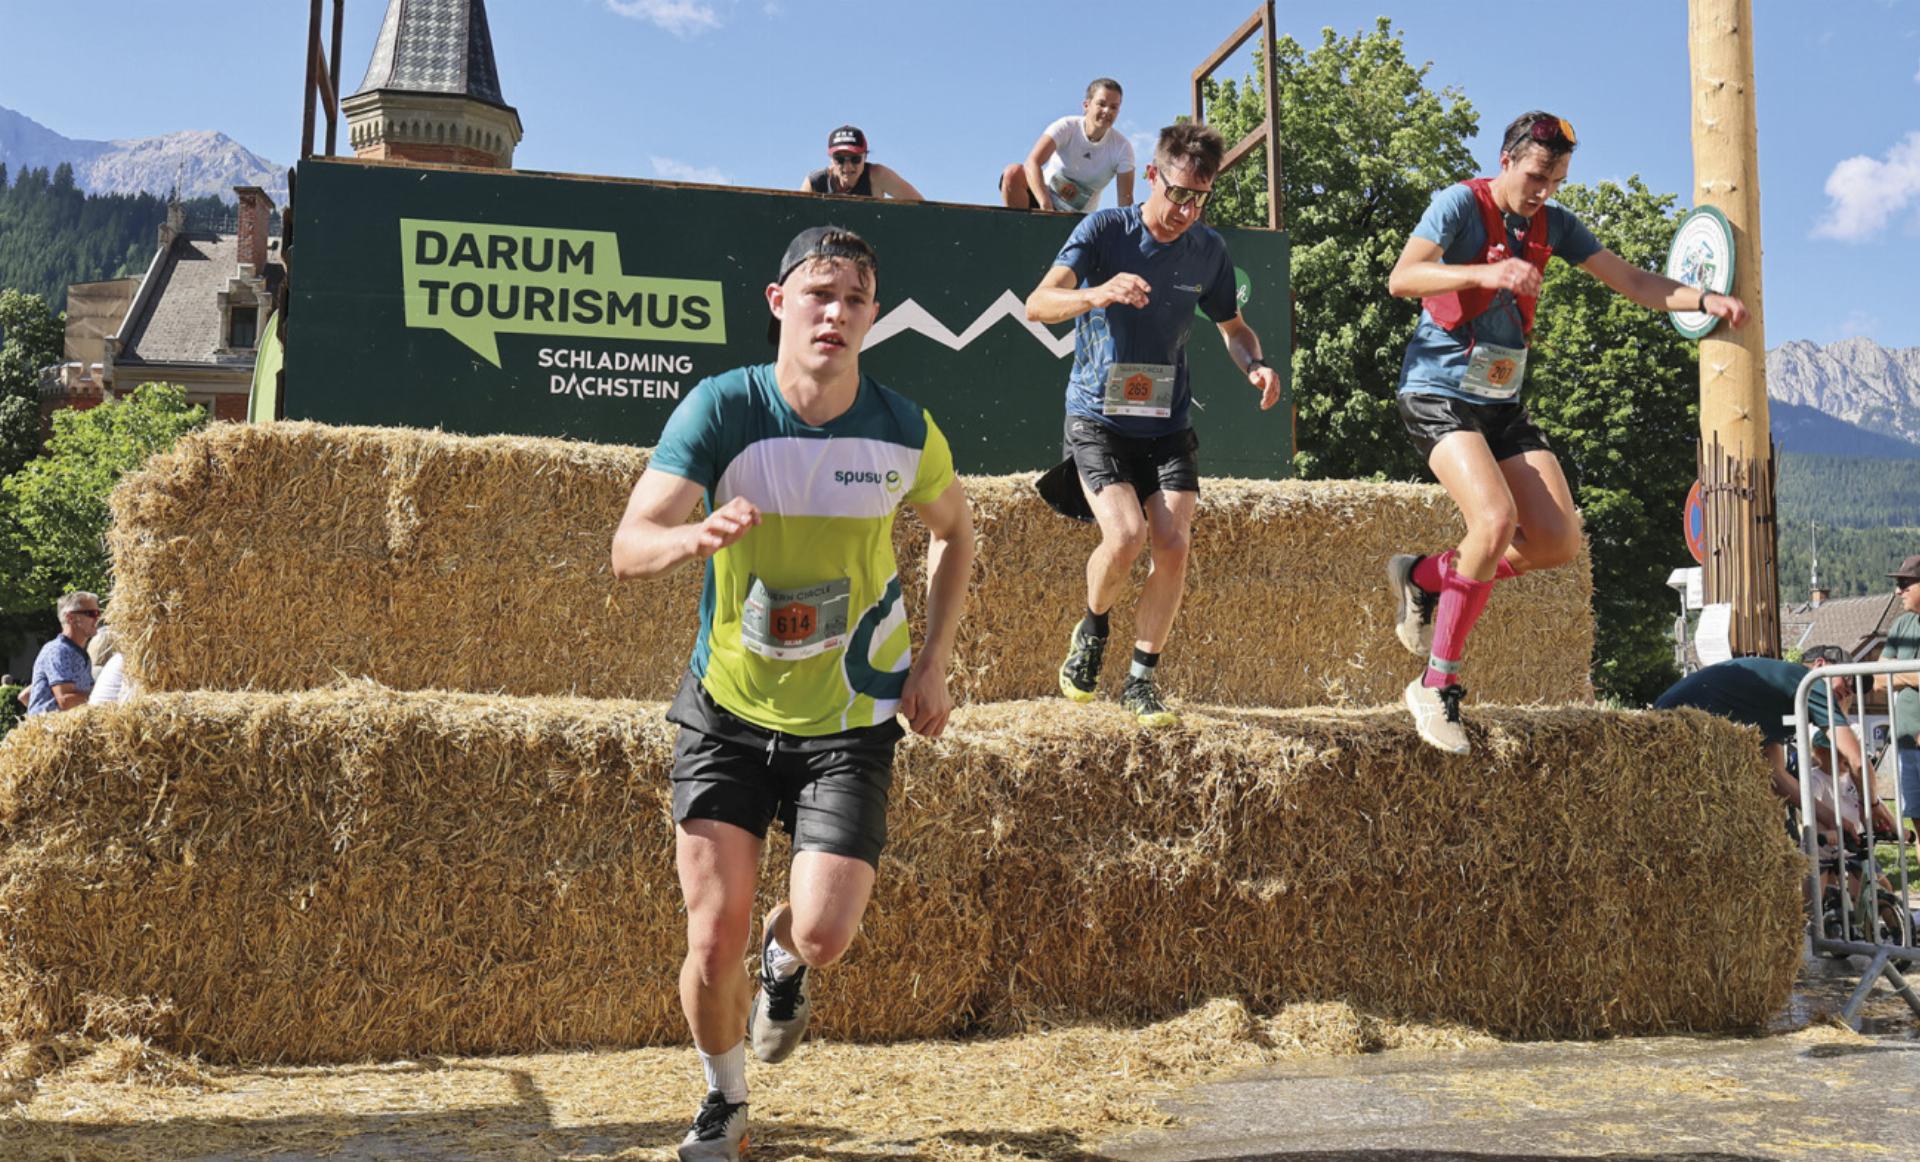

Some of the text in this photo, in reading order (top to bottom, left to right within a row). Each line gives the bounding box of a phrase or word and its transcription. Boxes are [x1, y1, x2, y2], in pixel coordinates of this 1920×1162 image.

[415, 230, 594, 275] DARUM
[419, 280, 711, 331] TOURISMUS
[538, 348, 693, 375] SCHLADMING
[550, 373, 679, 400] DACHSTEIN
[1128, 382, 1148, 396] 265
[835, 470, 882, 485] spusu
[776, 614, 810, 633] 614
